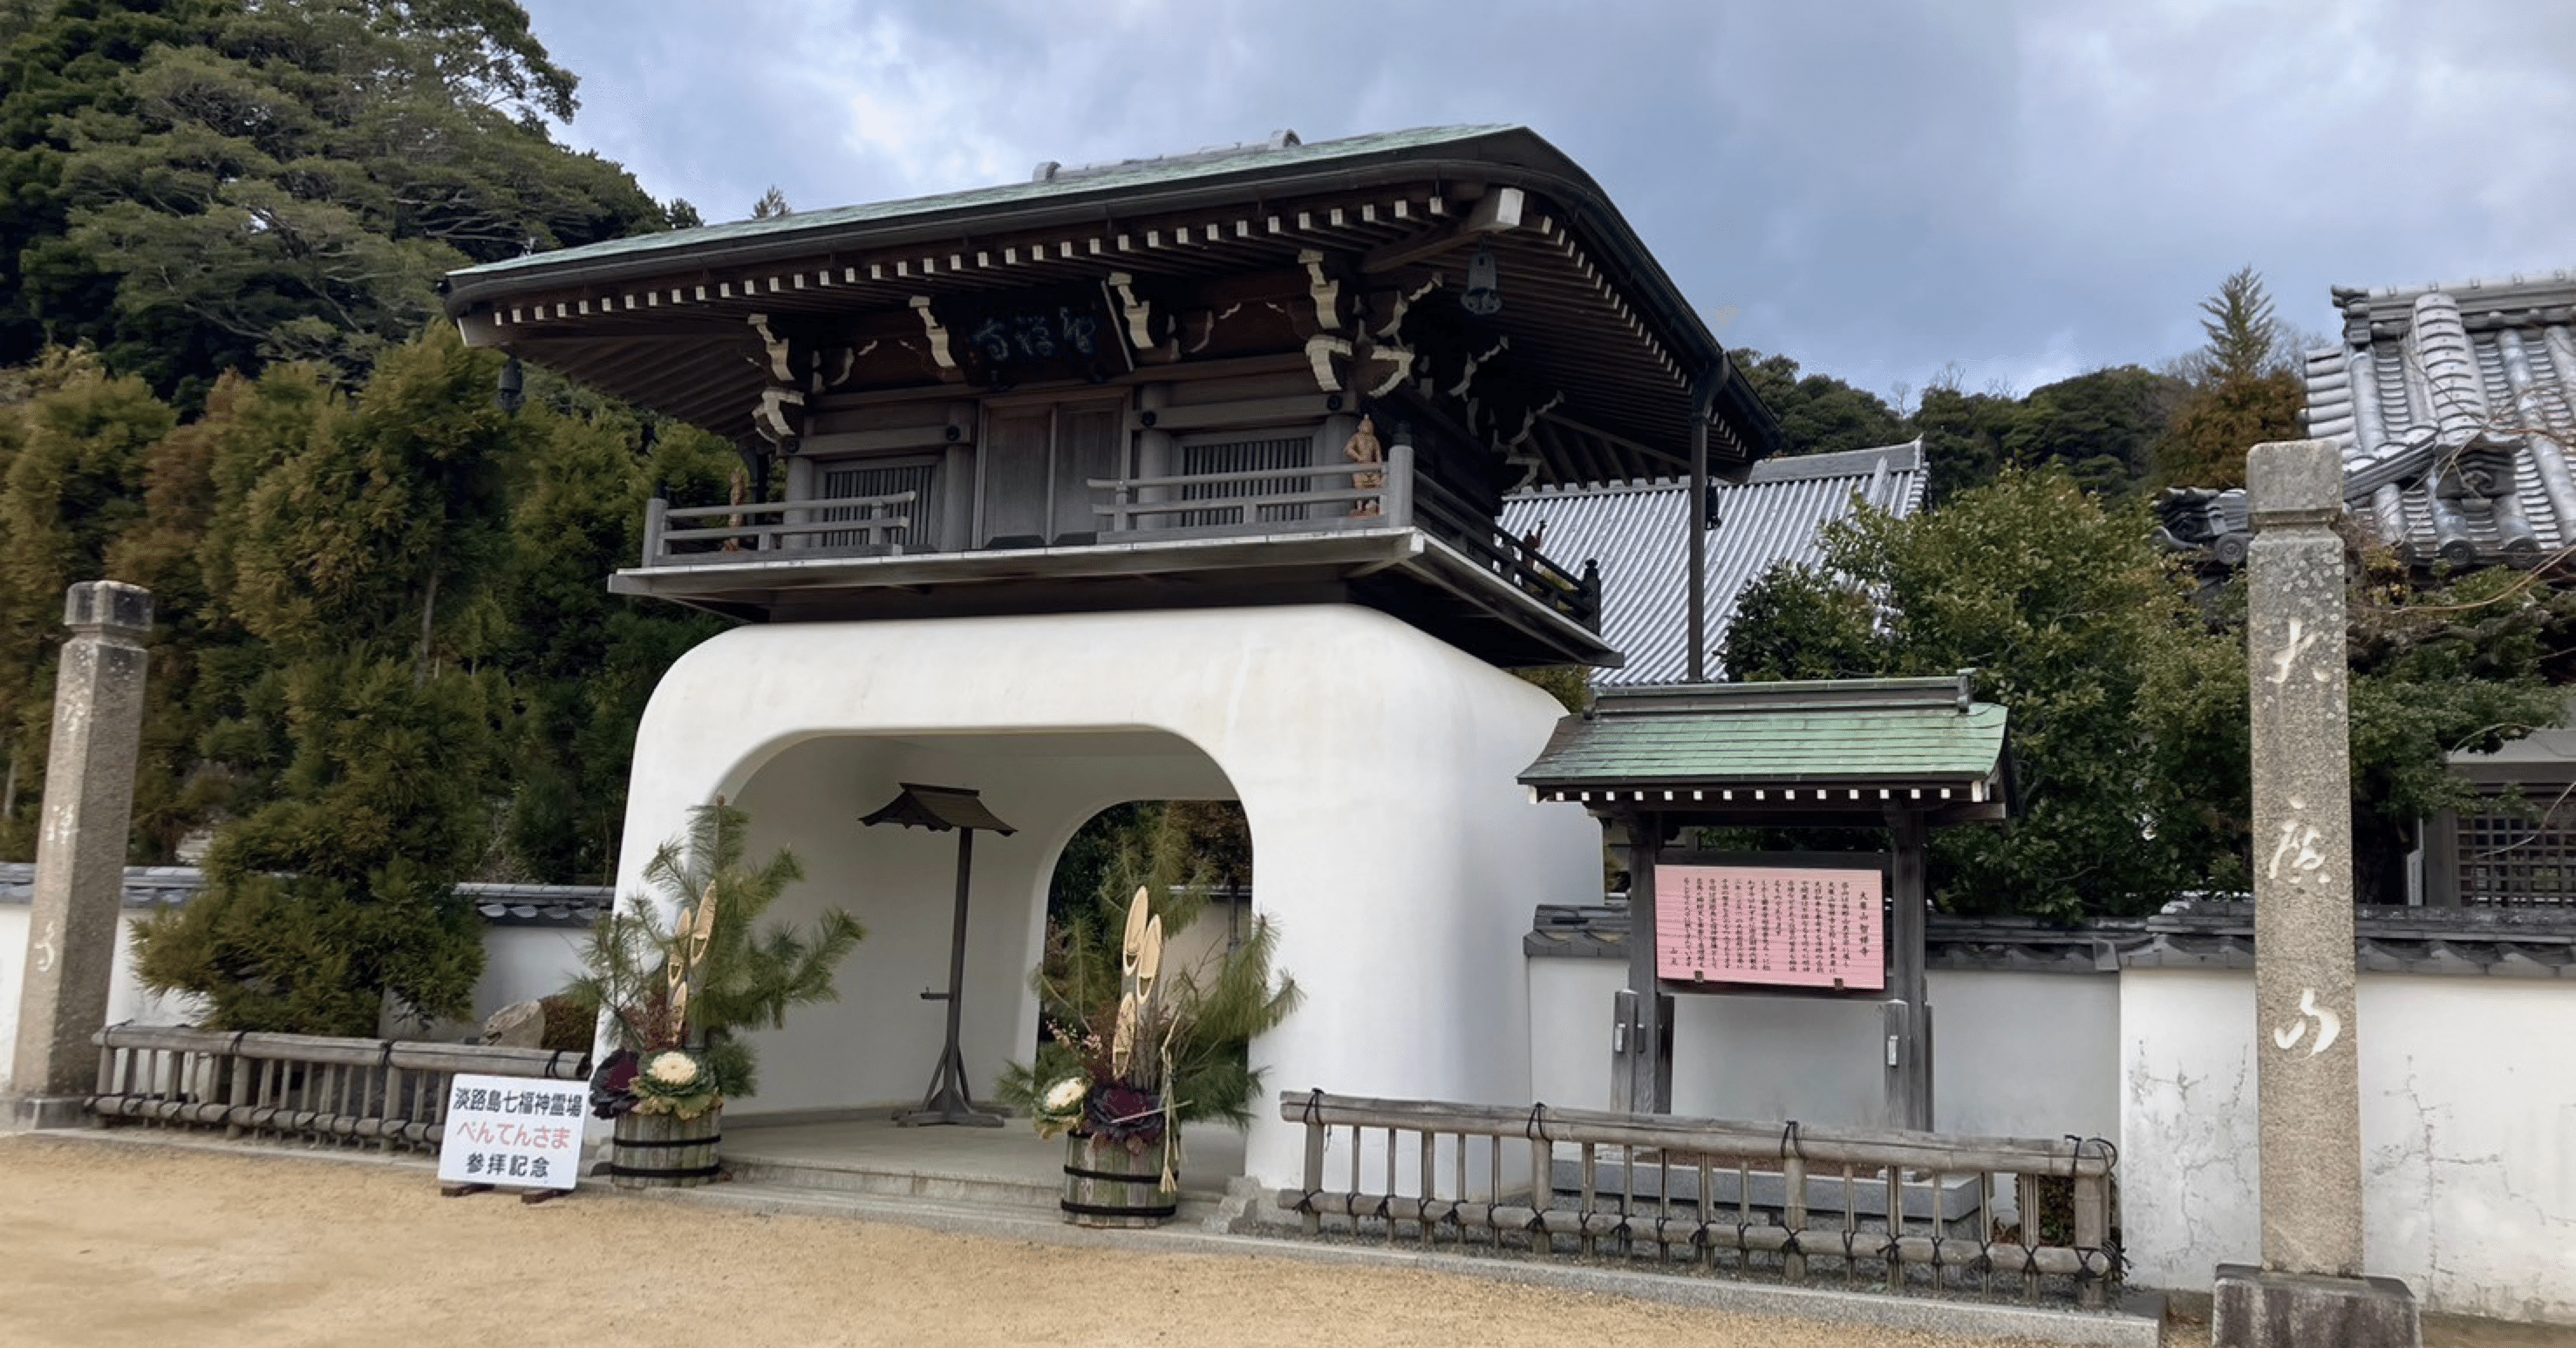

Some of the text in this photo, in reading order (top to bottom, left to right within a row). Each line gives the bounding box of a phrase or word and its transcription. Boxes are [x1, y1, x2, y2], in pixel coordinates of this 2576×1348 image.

[453, 1086, 583, 1118] 淡路島七福神霊場
[456, 1120, 572, 1150] べんてんさま
[466, 1152, 550, 1178] 参拝記念
